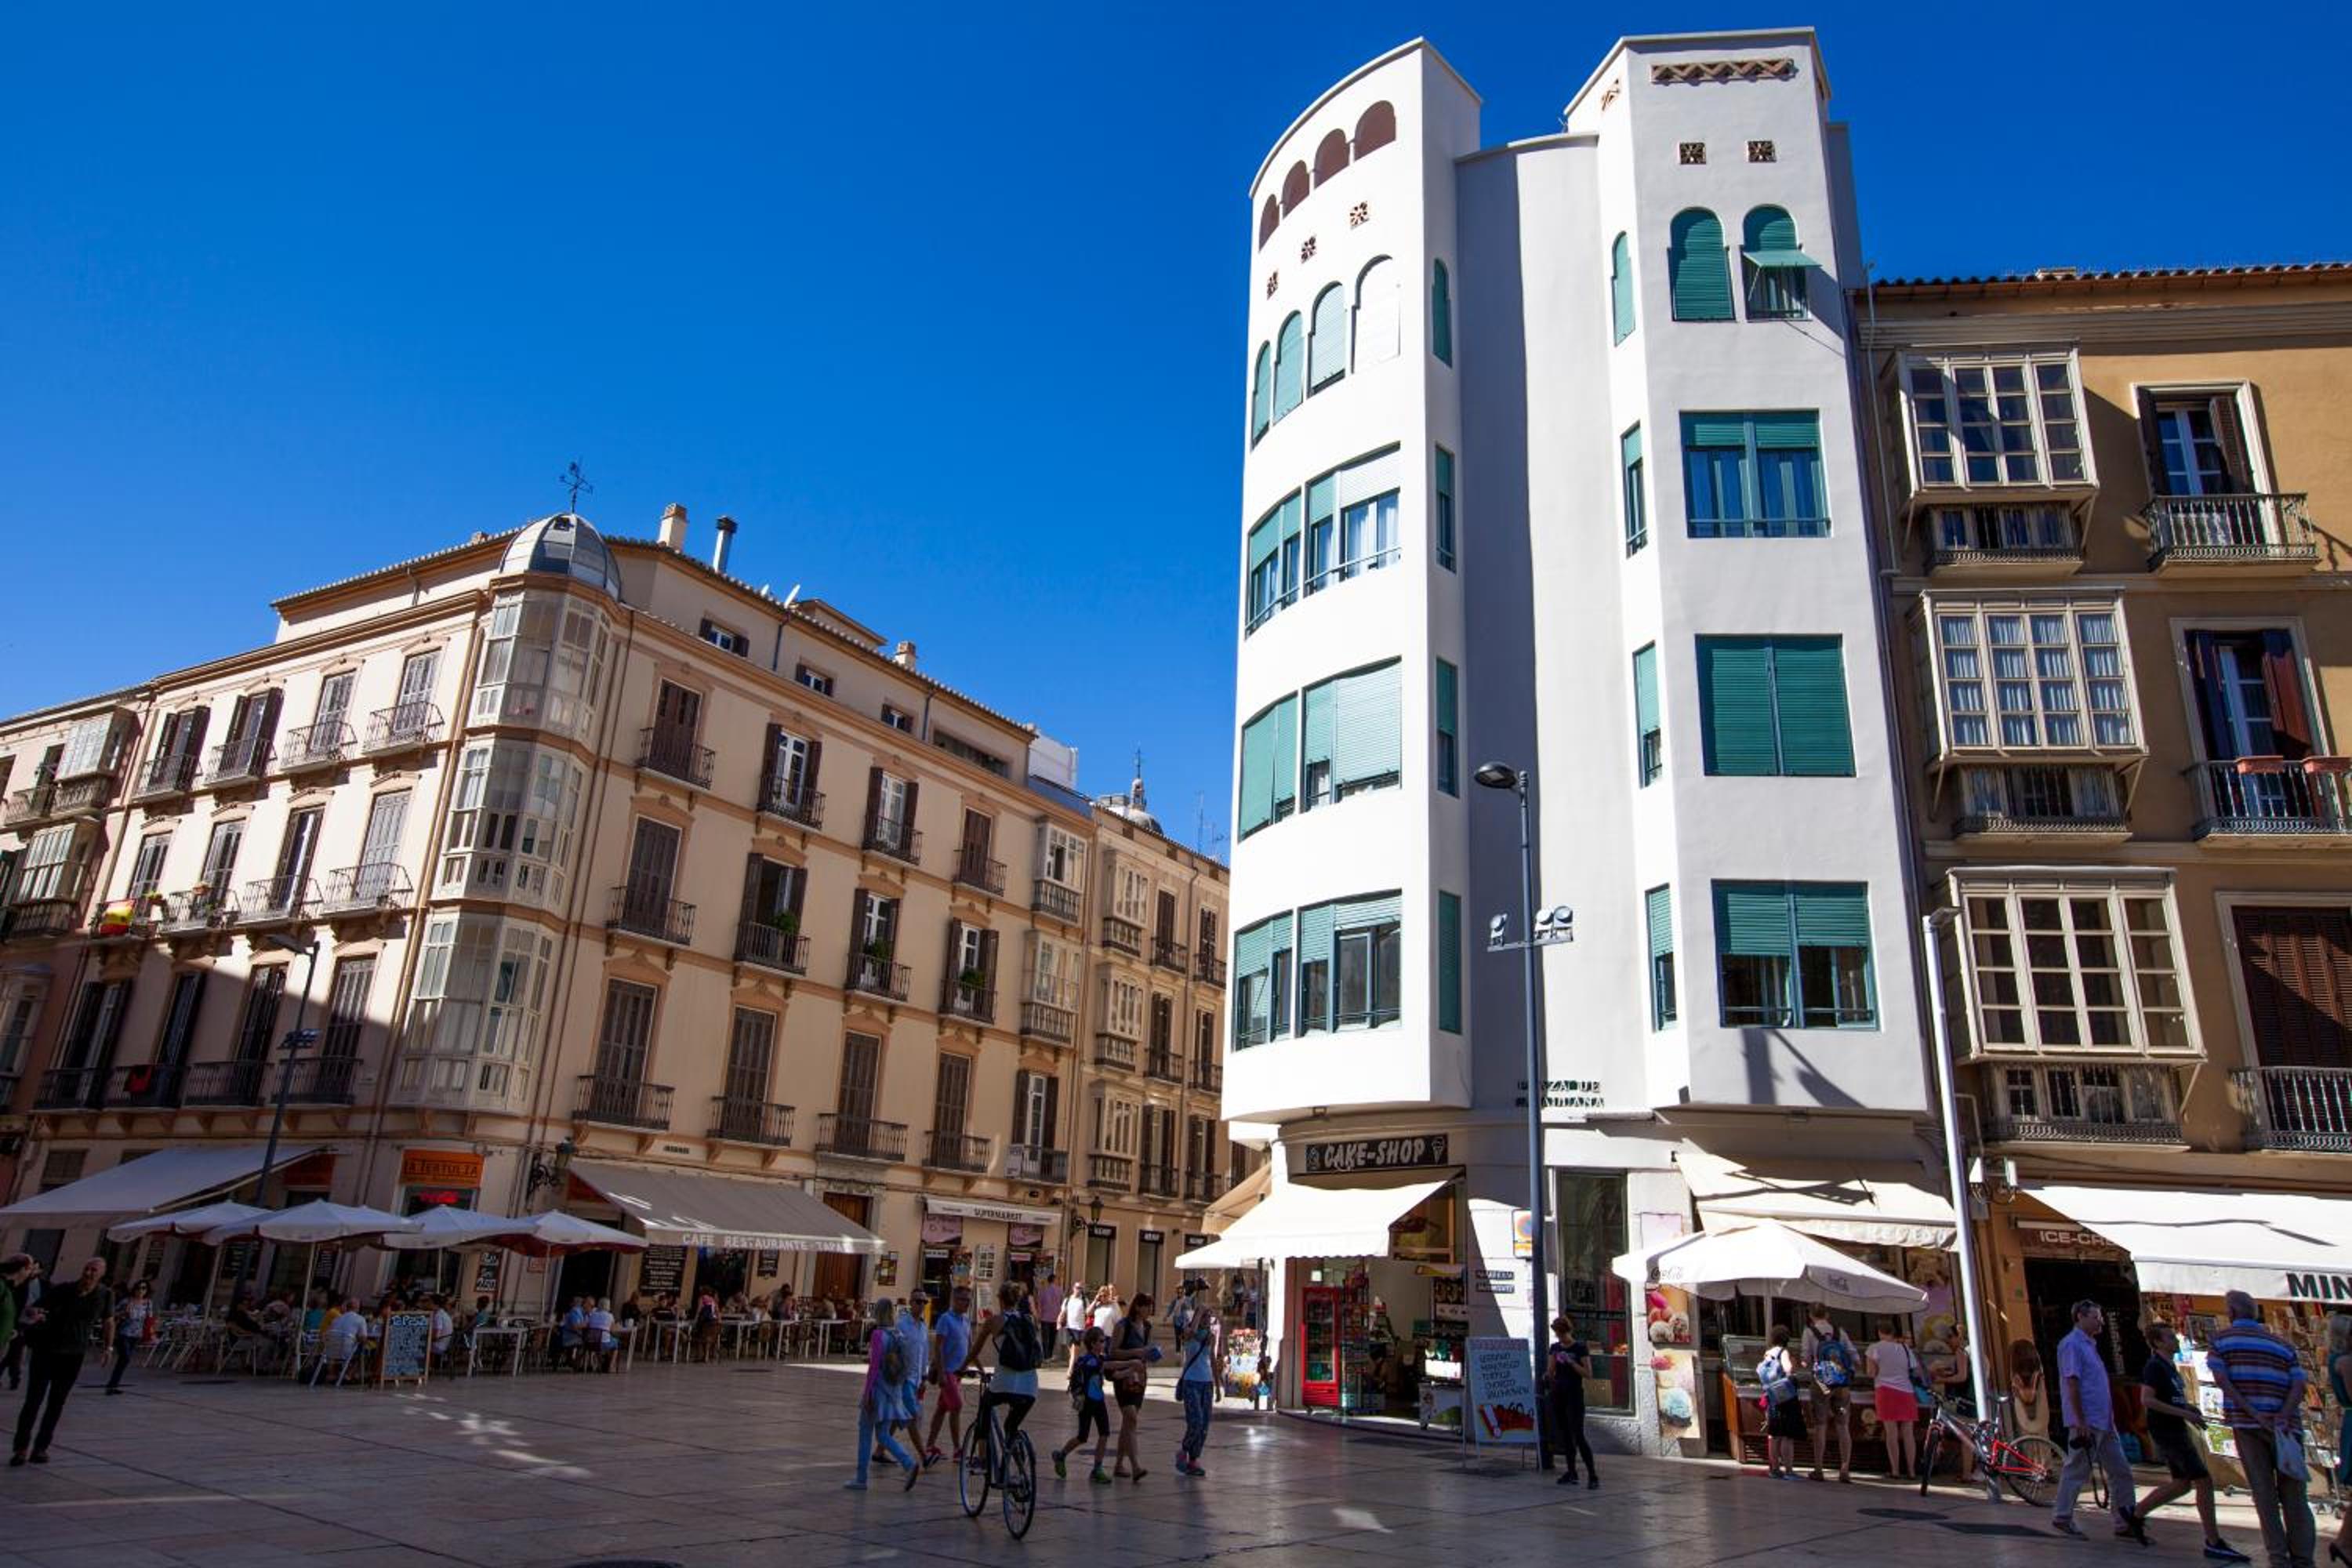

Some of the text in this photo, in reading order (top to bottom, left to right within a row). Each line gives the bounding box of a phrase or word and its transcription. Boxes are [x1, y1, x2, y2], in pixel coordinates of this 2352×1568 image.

[1324, 1138, 1425, 1168] CAKE-SHOP
[724, 1236, 811, 1251] RESTAURANTE
[815, 1242, 853, 1254] TAPA
